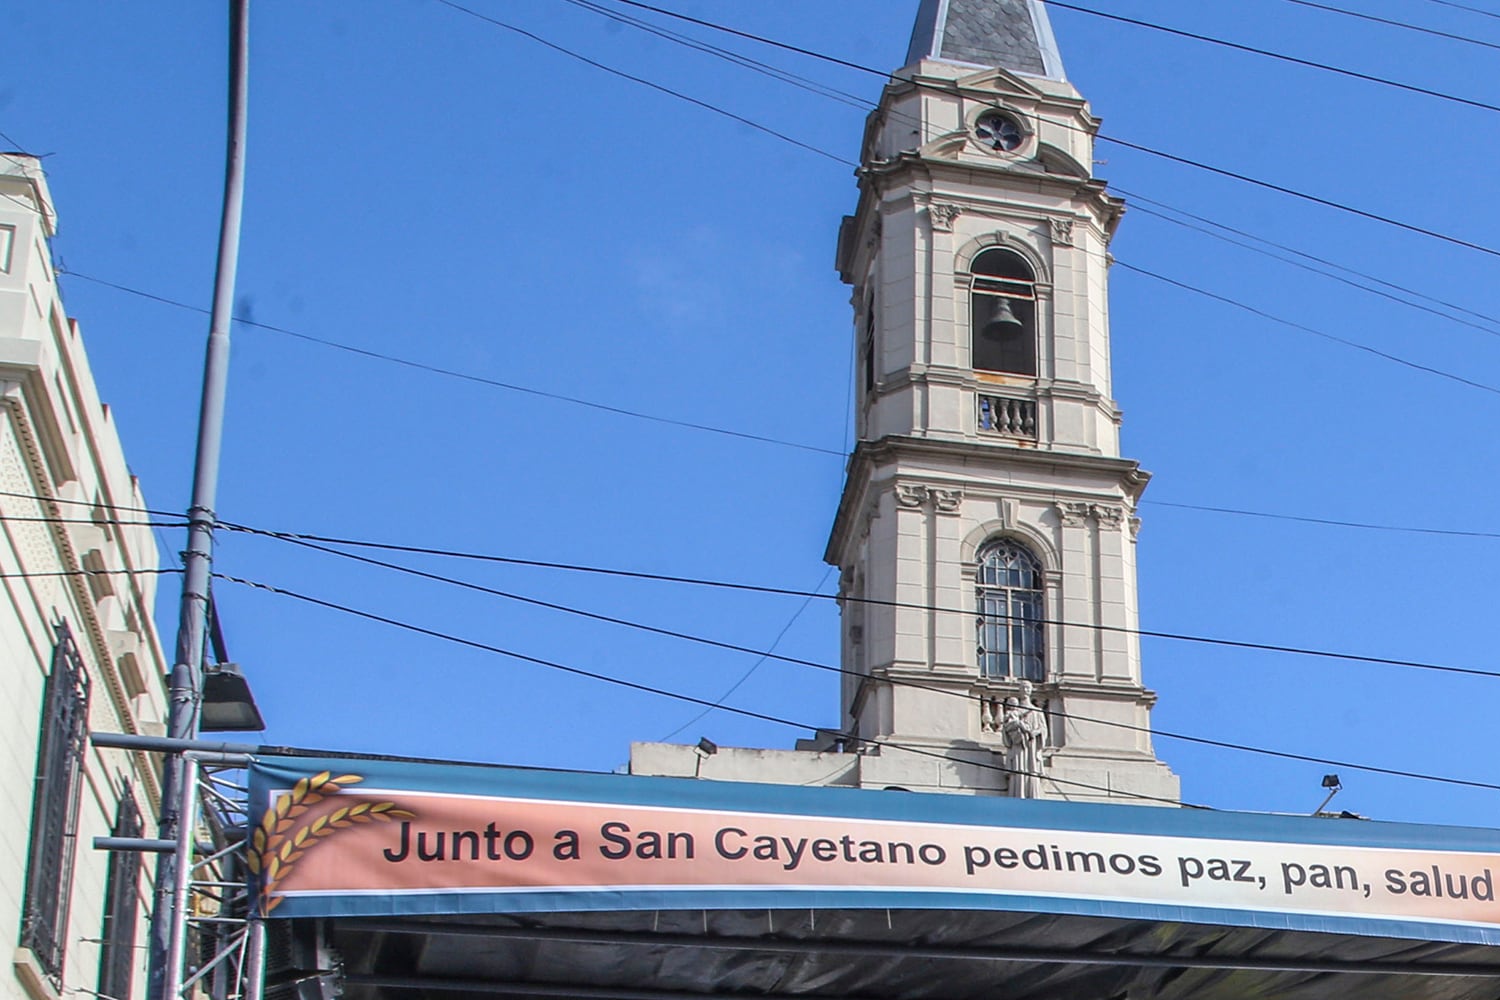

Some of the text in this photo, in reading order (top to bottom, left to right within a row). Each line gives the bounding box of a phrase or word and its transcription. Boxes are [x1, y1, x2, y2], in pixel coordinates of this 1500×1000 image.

[383, 820, 535, 864] Junto
[553, 828, 581, 861] a
[599, 820, 695, 861] San
[714, 826, 945, 871] Cayetano
[963, 838, 1163, 877] pedimos
[1177, 851, 1267, 891] paz,
[1282, 859, 1372, 899] pan,
[1385, 863, 1494, 903] salud
